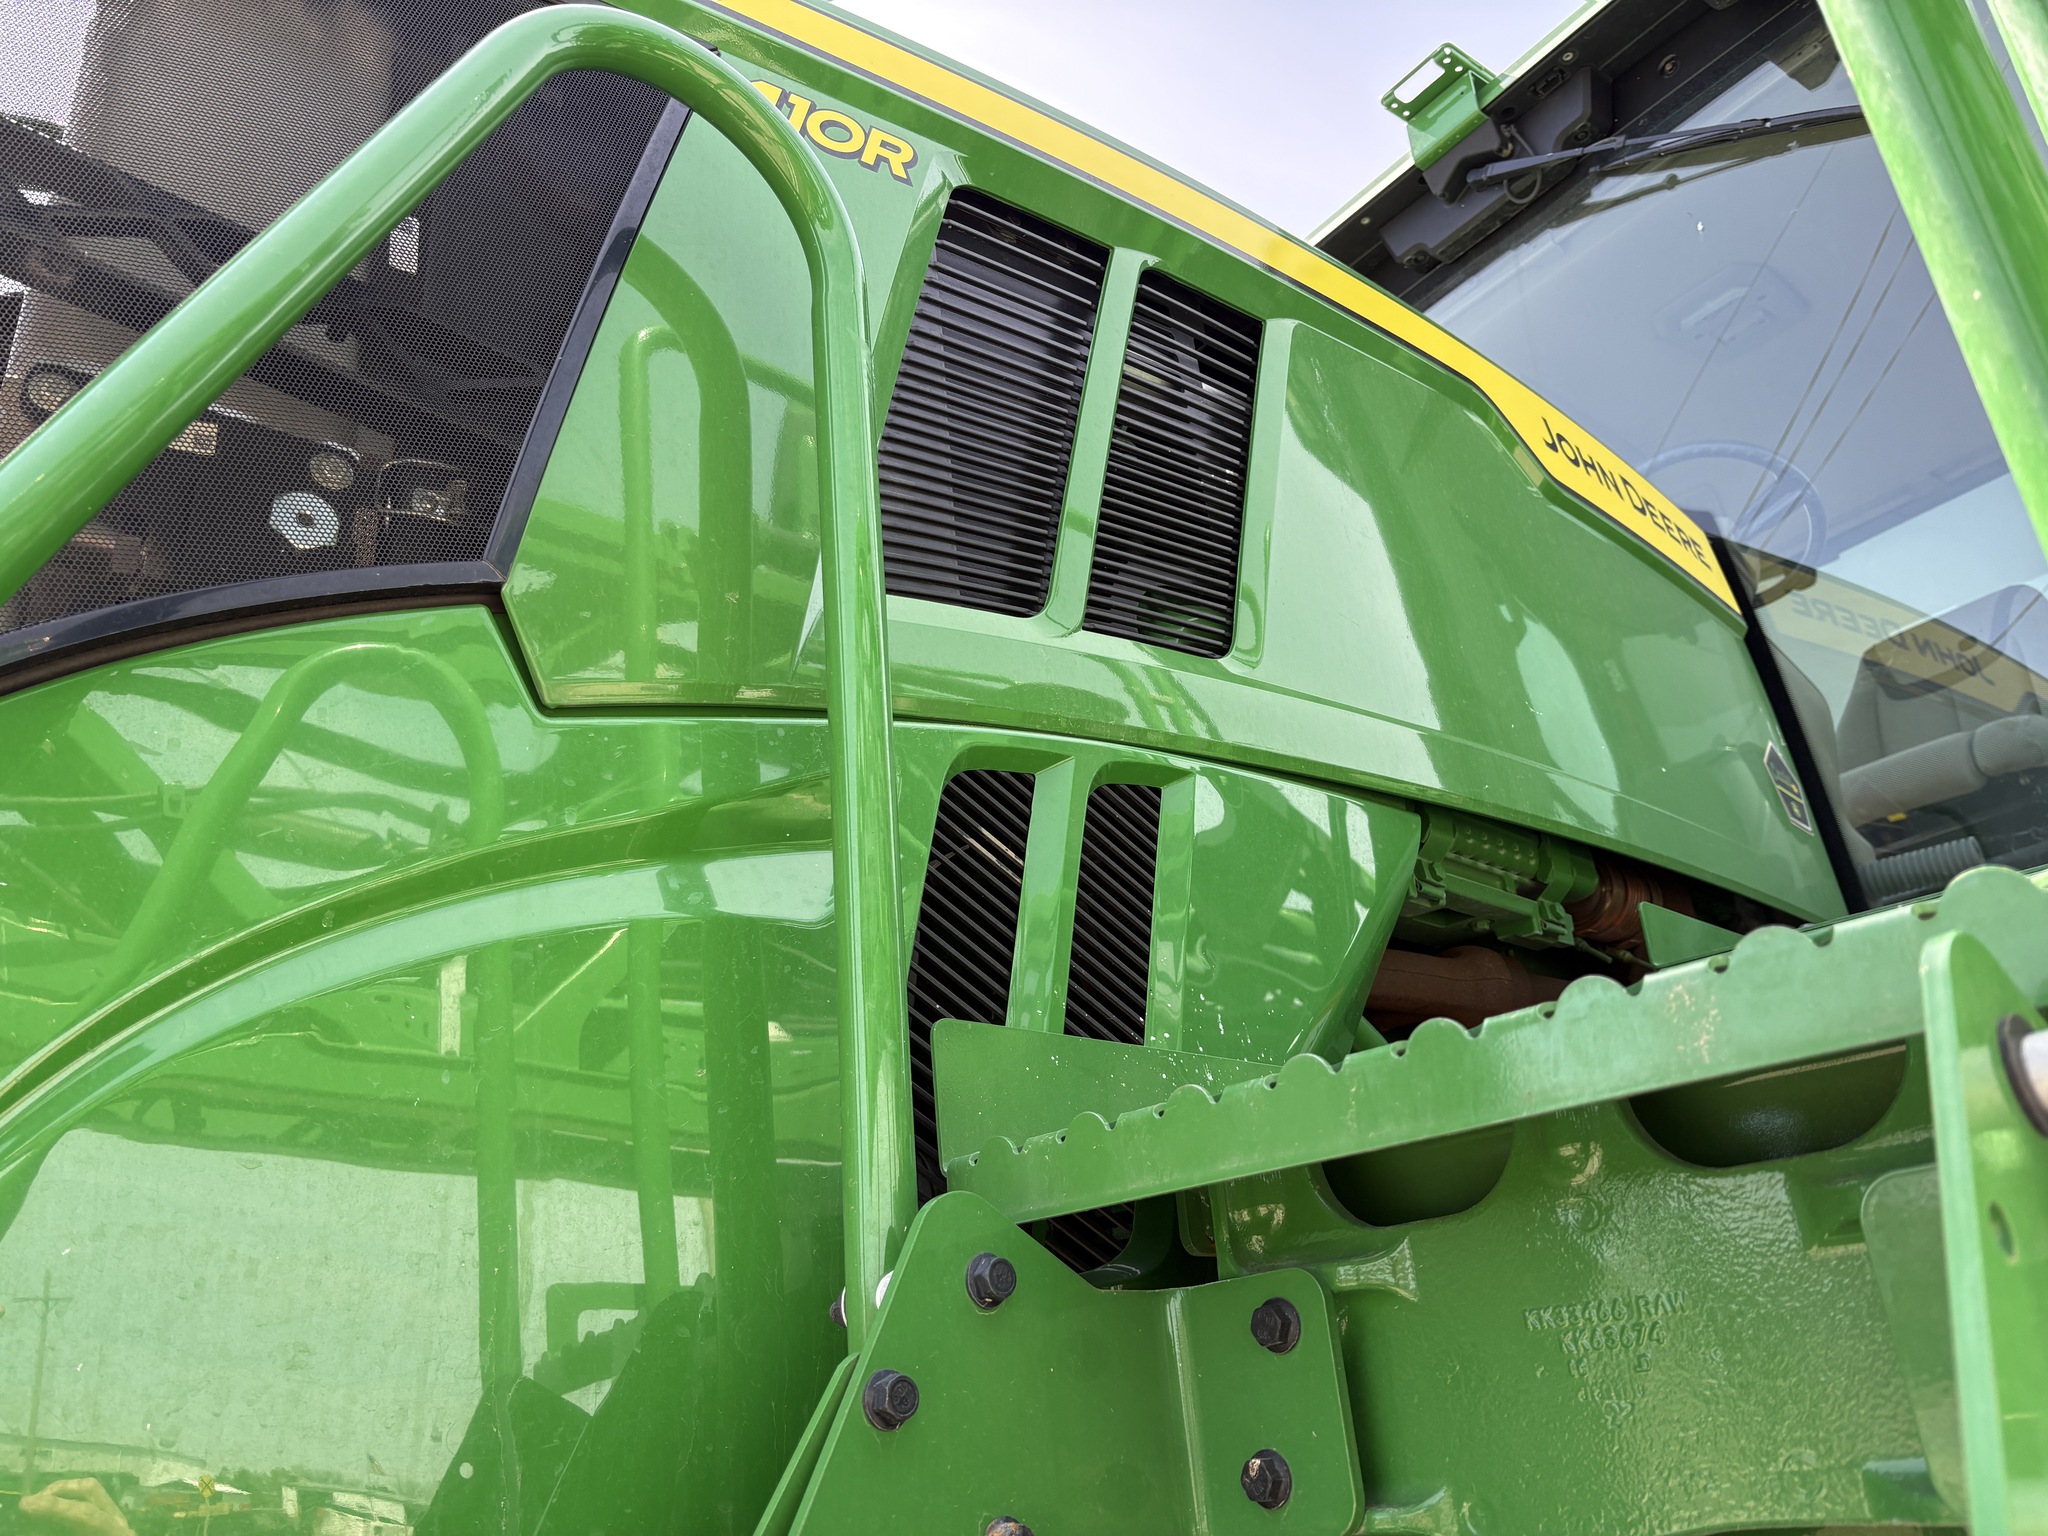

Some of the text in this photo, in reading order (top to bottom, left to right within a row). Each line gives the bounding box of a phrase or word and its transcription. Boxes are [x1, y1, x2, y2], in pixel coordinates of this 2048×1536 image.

[1541, 416, 1713, 572] JOHN DEERE
[1633, 1290, 1689, 1322] RAW
